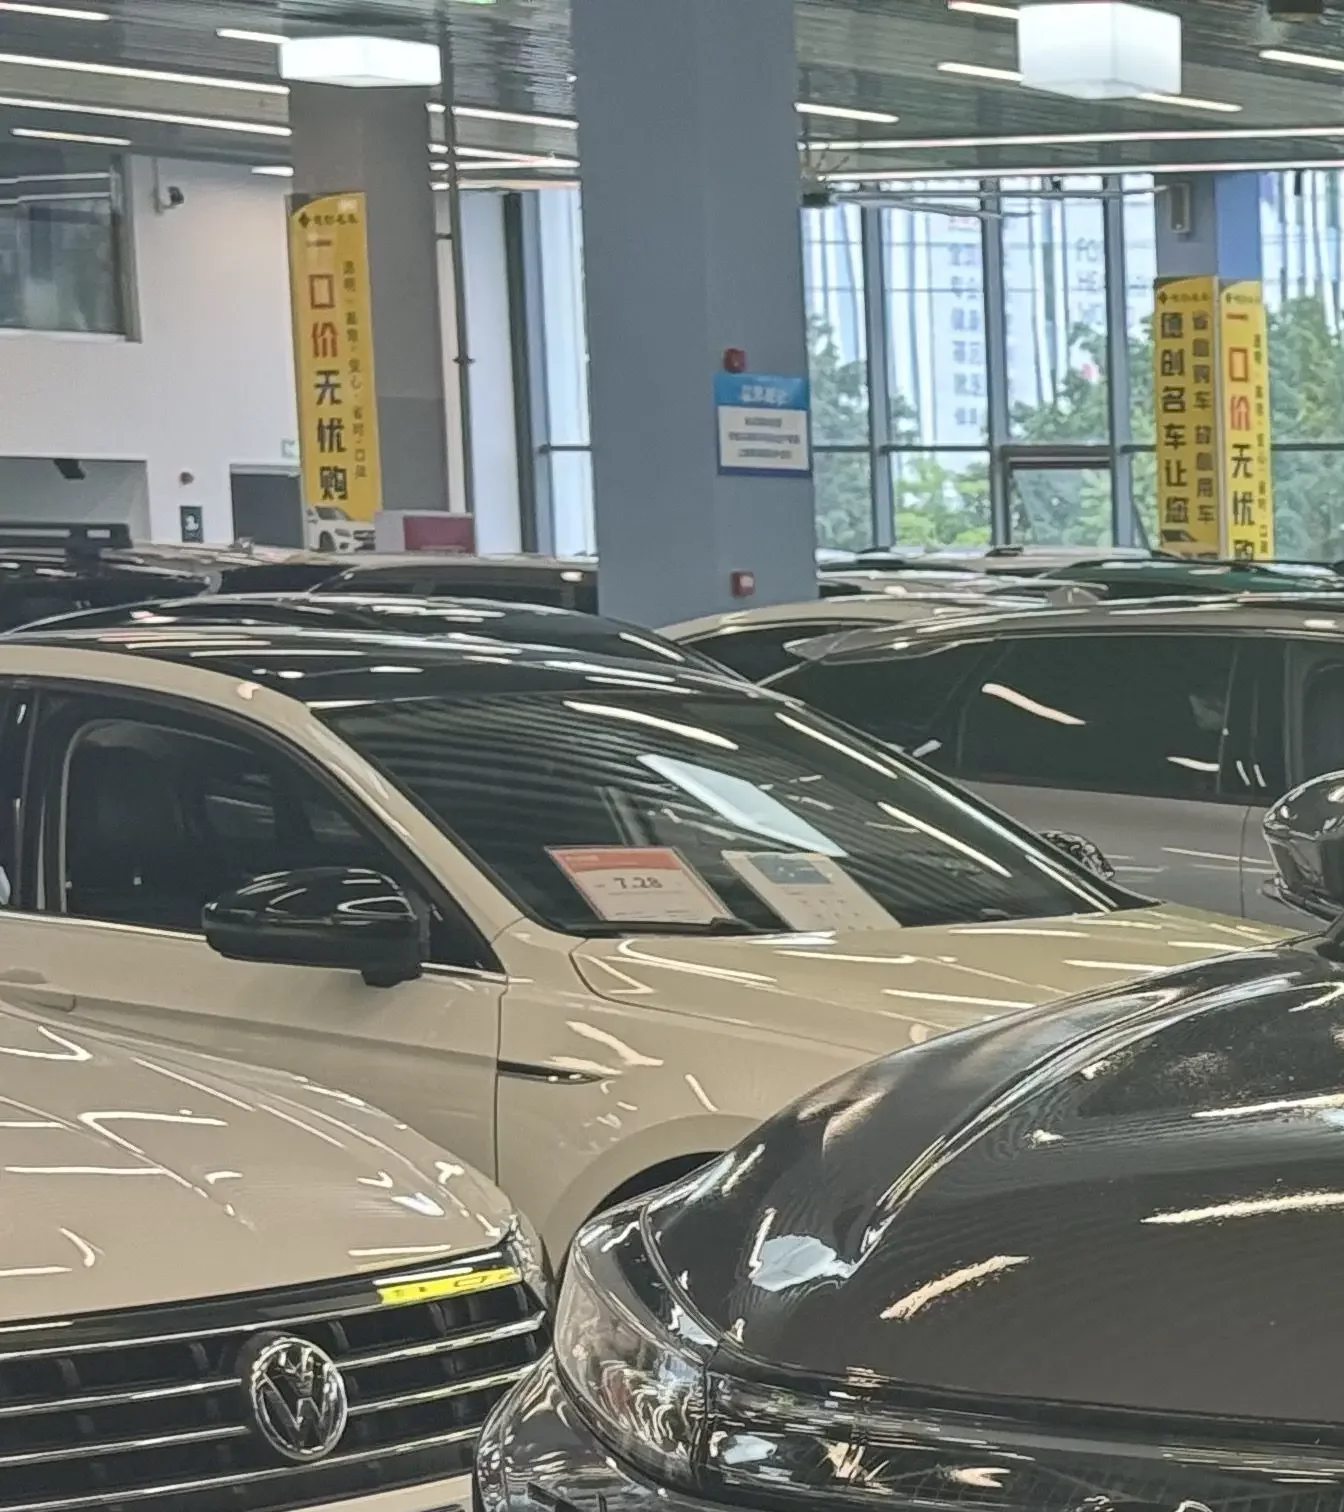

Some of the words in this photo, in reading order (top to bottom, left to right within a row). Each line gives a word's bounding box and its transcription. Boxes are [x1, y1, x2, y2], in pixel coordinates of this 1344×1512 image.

[306, 238, 348, 501] 一口价无忧购
[613, 876, 664, 890] 7.28
